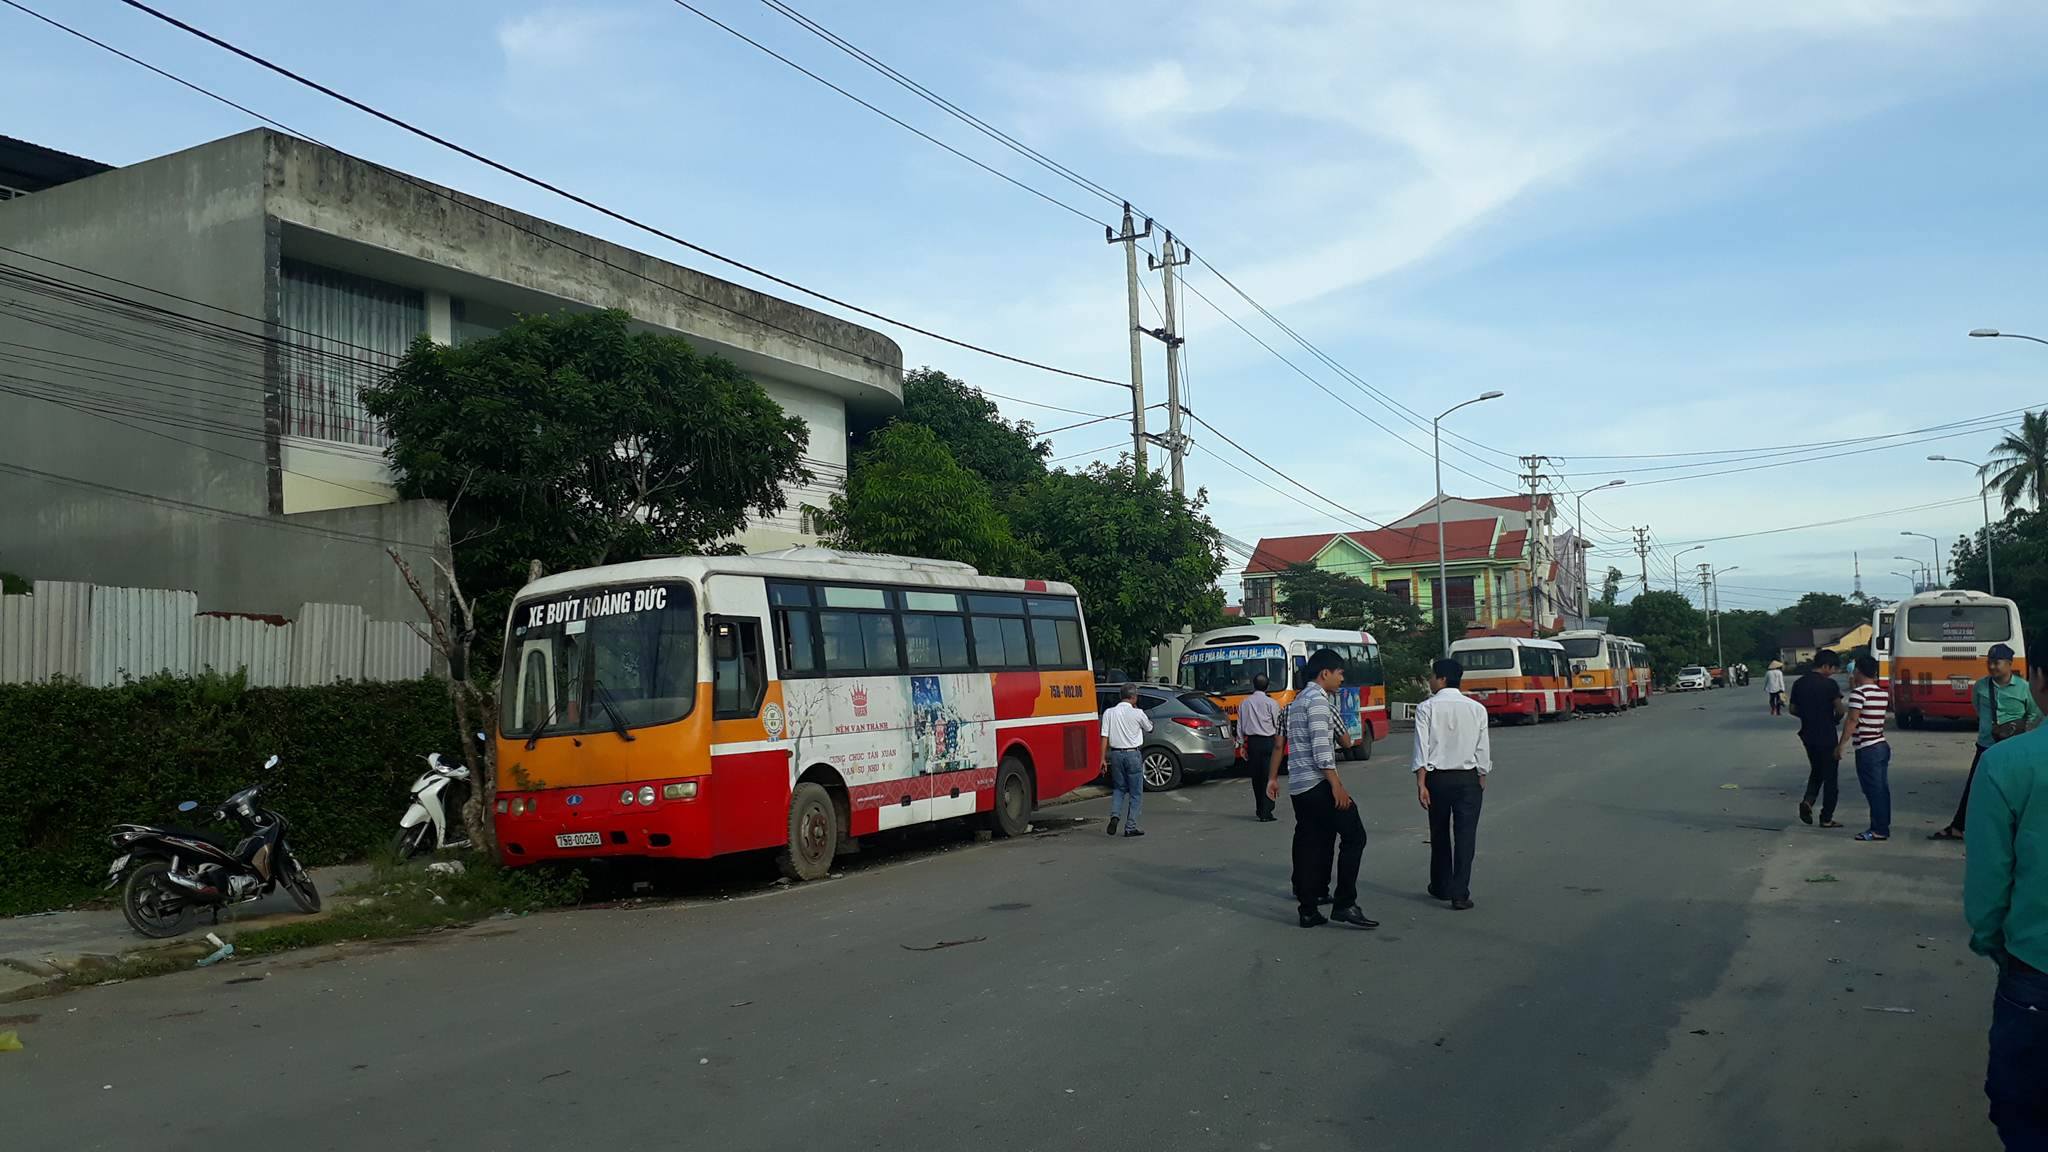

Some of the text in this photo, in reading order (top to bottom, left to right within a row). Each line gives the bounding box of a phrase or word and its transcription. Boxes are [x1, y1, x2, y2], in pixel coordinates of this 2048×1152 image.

[527, 585, 668, 628] XE BUÝT HOÀNG ĐỨC
